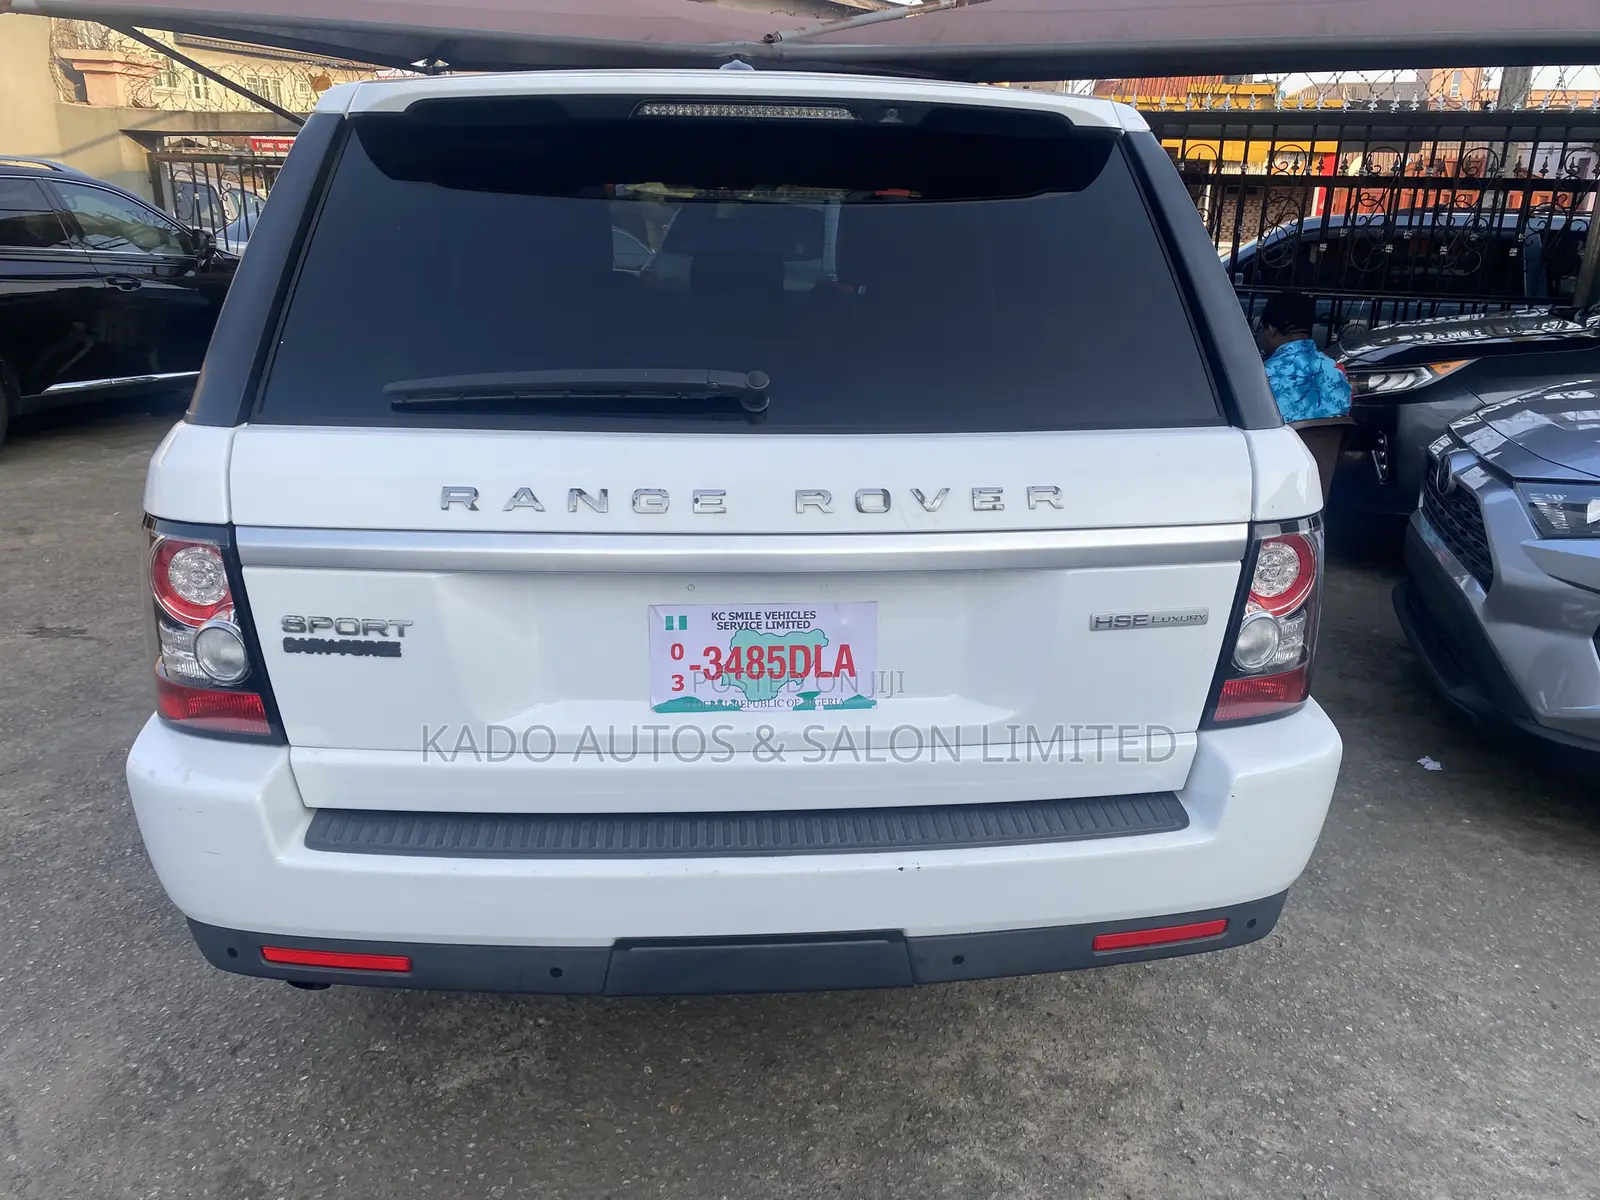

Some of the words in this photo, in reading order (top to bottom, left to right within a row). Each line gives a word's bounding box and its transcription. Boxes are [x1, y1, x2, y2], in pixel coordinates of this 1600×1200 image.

[441, 486, 727, 514] RANGE
[795, 485, 1064, 514] ROVER
[711, 612, 726, 621] KC
[728, 611, 762, 621] SMILE
[764, 610, 817, 620] VEHICLES
[1094, 614, 1149, 629] HSE
[1151, 614, 1206, 624] LUXURY
[281, 614, 413, 638] SPORT
[716, 621, 763, 630] SERVICE
[765, 620, 811, 629] LIMITED
[683, 699, 732, 708] FEDERAL
[734, 699, 783, 709] REPUBLIC
[786, 699, 800, 708] OF
